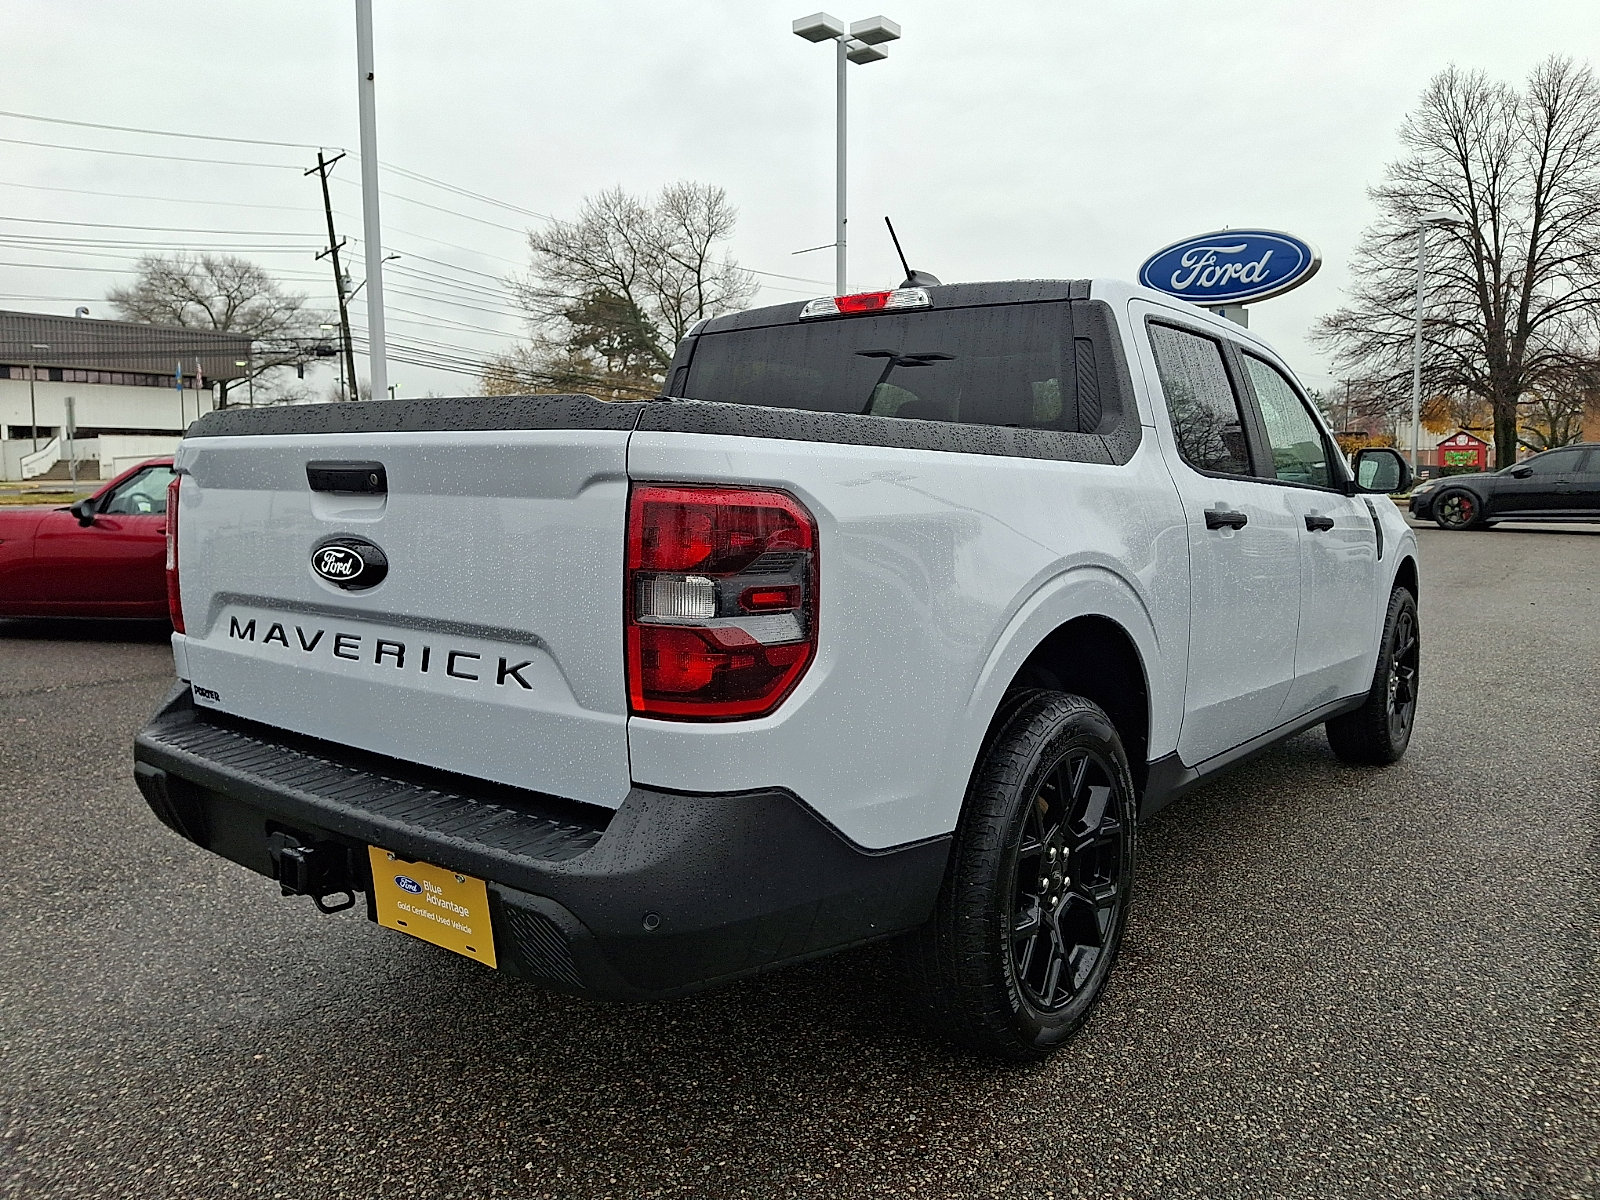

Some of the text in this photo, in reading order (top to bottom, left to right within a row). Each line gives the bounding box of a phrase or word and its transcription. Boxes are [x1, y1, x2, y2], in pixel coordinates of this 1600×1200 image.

[1170, 243, 1274, 290] Ford
[321, 550, 353, 575] Ford
[228, 615, 534, 690] MAVERICK
[193, 684, 220, 702] PORTER
[399, 877, 418, 892] Ford
[423, 880, 442, 896] Blue
[426, 892, 470, 917] Advantage
[397, 901, 472, 935] Gold Certified Used Vehicle
